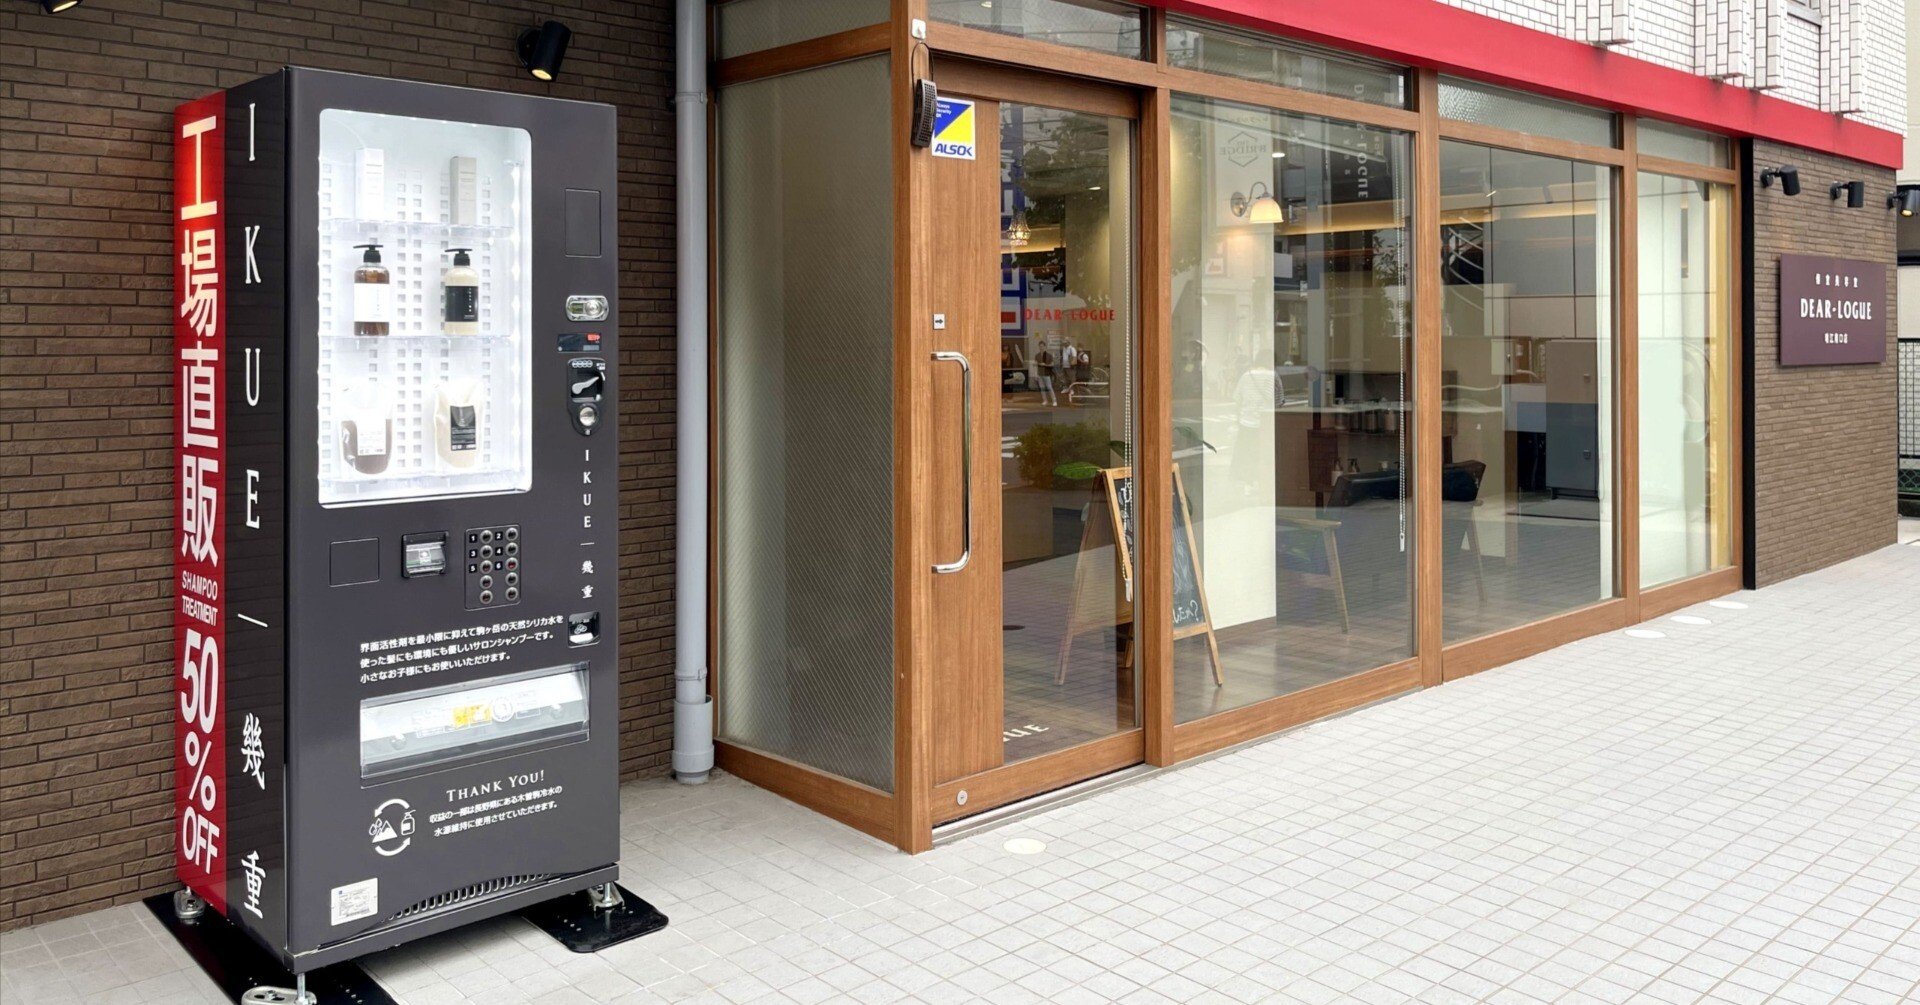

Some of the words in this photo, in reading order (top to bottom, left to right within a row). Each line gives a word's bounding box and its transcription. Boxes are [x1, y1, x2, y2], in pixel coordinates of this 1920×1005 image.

[934, 143, 973, 157] ALSOK
[244, 103, 261, 529] IKUE
[181, 115, 219, 568] 工場直販
[583, 449, 592, 528] IKUE
[181, 570, 218, 600] SHAMPOO
[181, 594, 219, 626] TREATMENT
[360, 651, 511, 684] 小さなお子様にもお使いいただけます。
[446, 780, 503, 802] THANK
[508, 770, 545, 788] YOU!
[182, 806, 220, 874] OFF
[241, 713, 266, 919] 幾重
